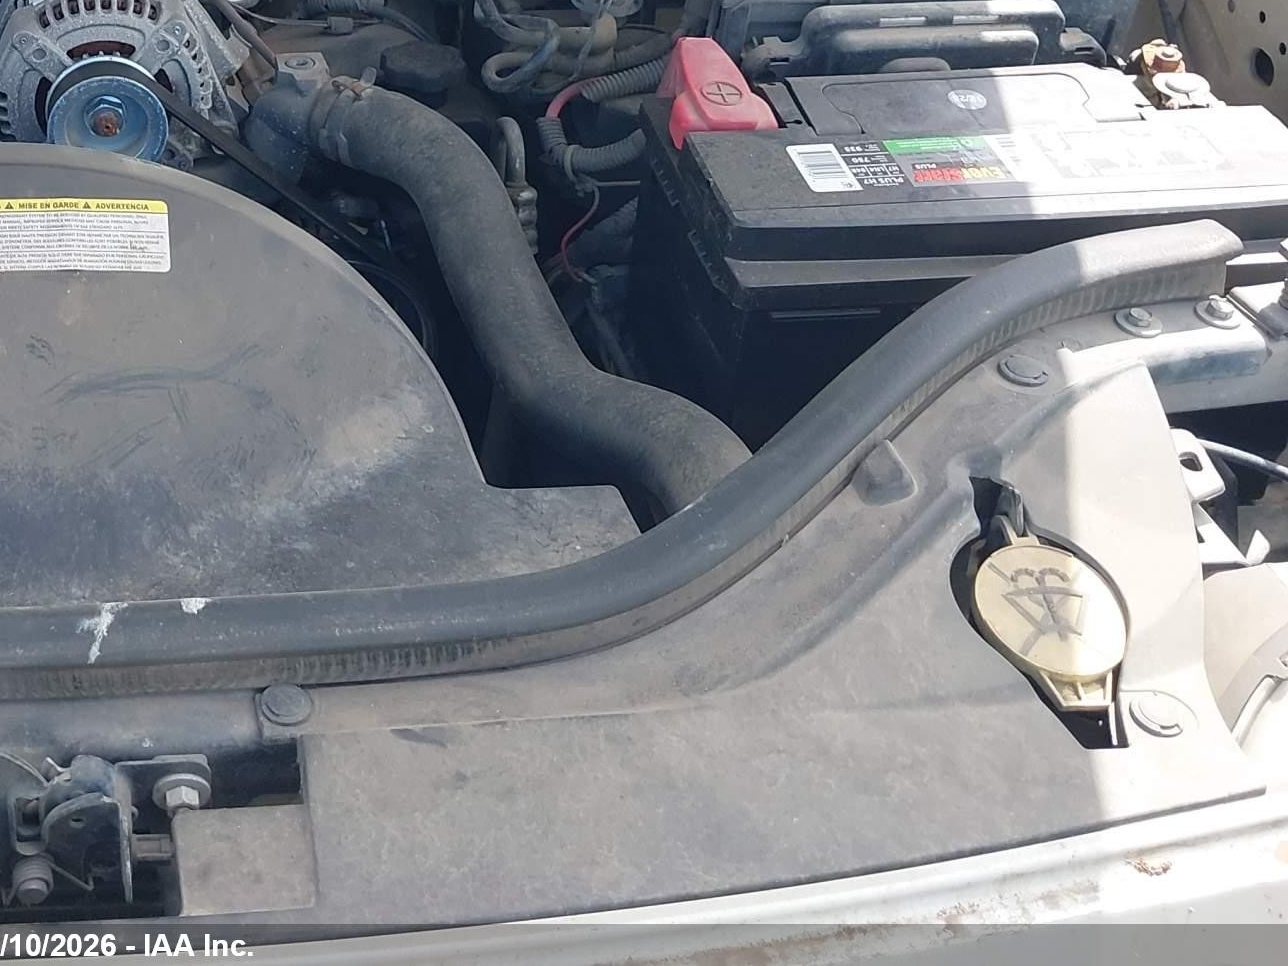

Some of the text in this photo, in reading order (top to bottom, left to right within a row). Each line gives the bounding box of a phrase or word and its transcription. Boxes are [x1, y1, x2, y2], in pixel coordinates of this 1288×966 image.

[863, 177, 879, 185] H7
[18, 202, 38, 210] MISE
[52, 201, 79, 209] GARDE
[95, 202, 150, 211] ADVERTENCIA
